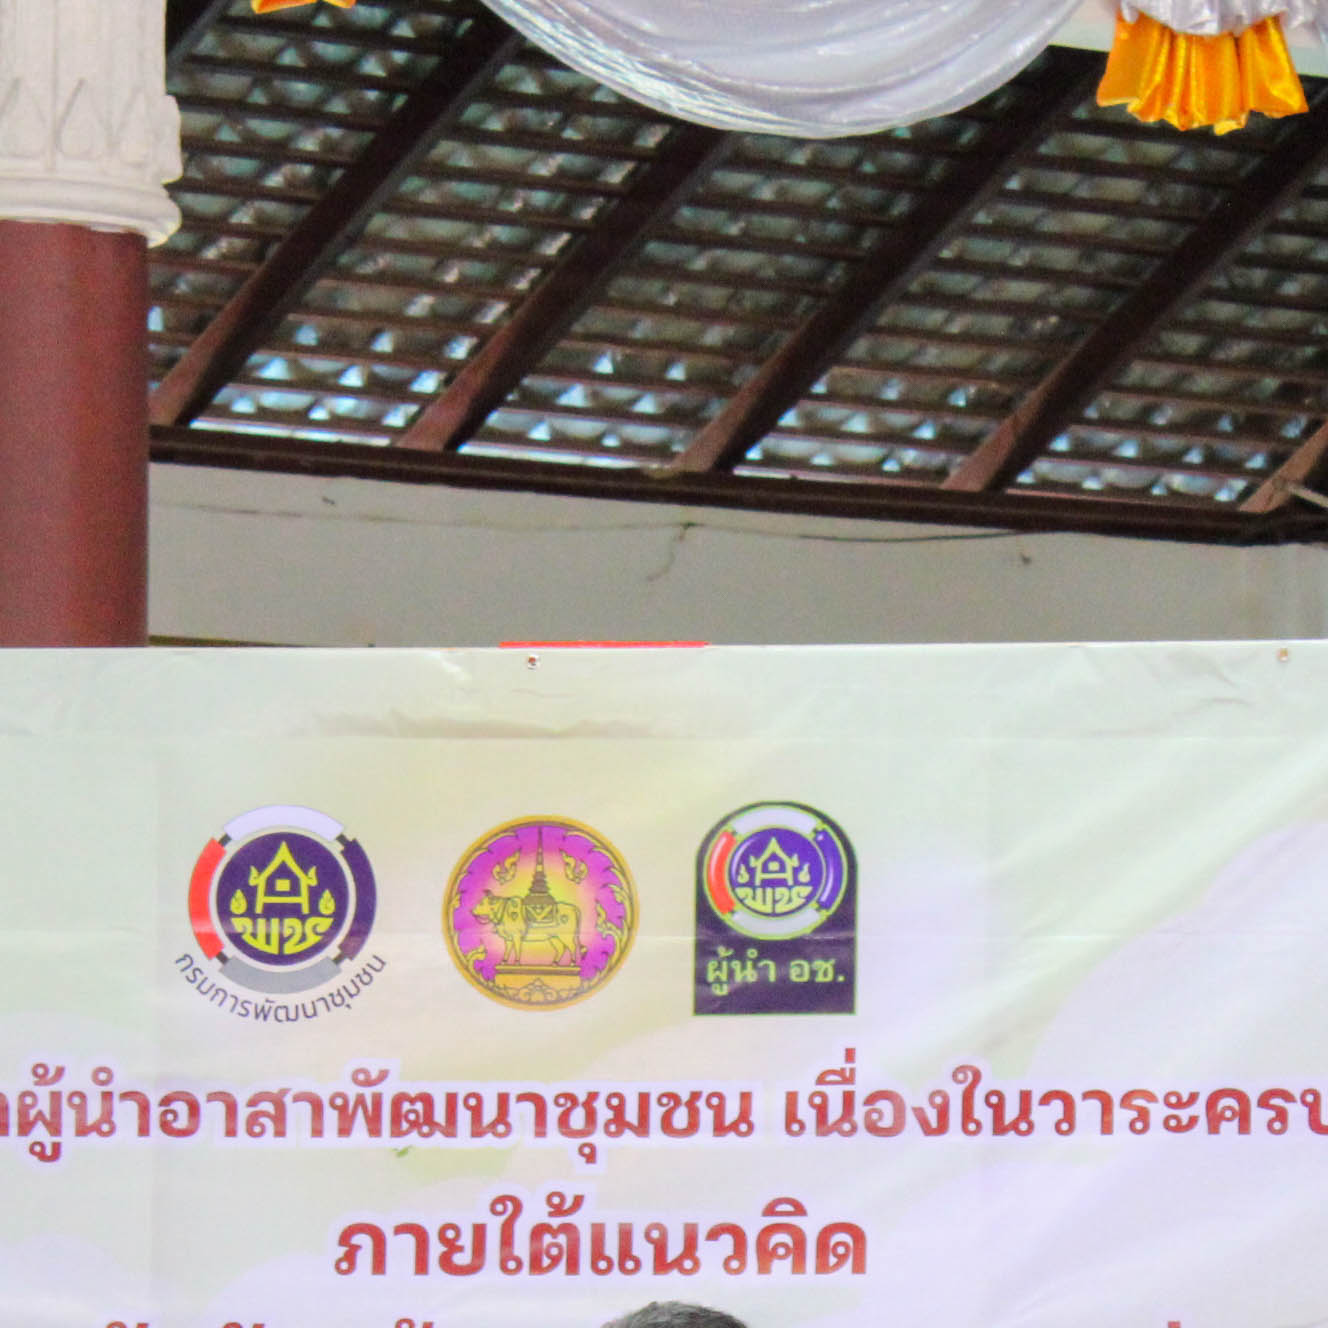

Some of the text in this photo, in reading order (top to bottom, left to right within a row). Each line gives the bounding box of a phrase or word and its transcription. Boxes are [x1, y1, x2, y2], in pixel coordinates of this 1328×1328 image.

[174, 952, 388, 1024] กรมการพัฒนาชุมชน
[706, 946, 846, 996] ผู้นำ อช.
[333, 1190, 867, 1277] ภายใต้แนวคิด
